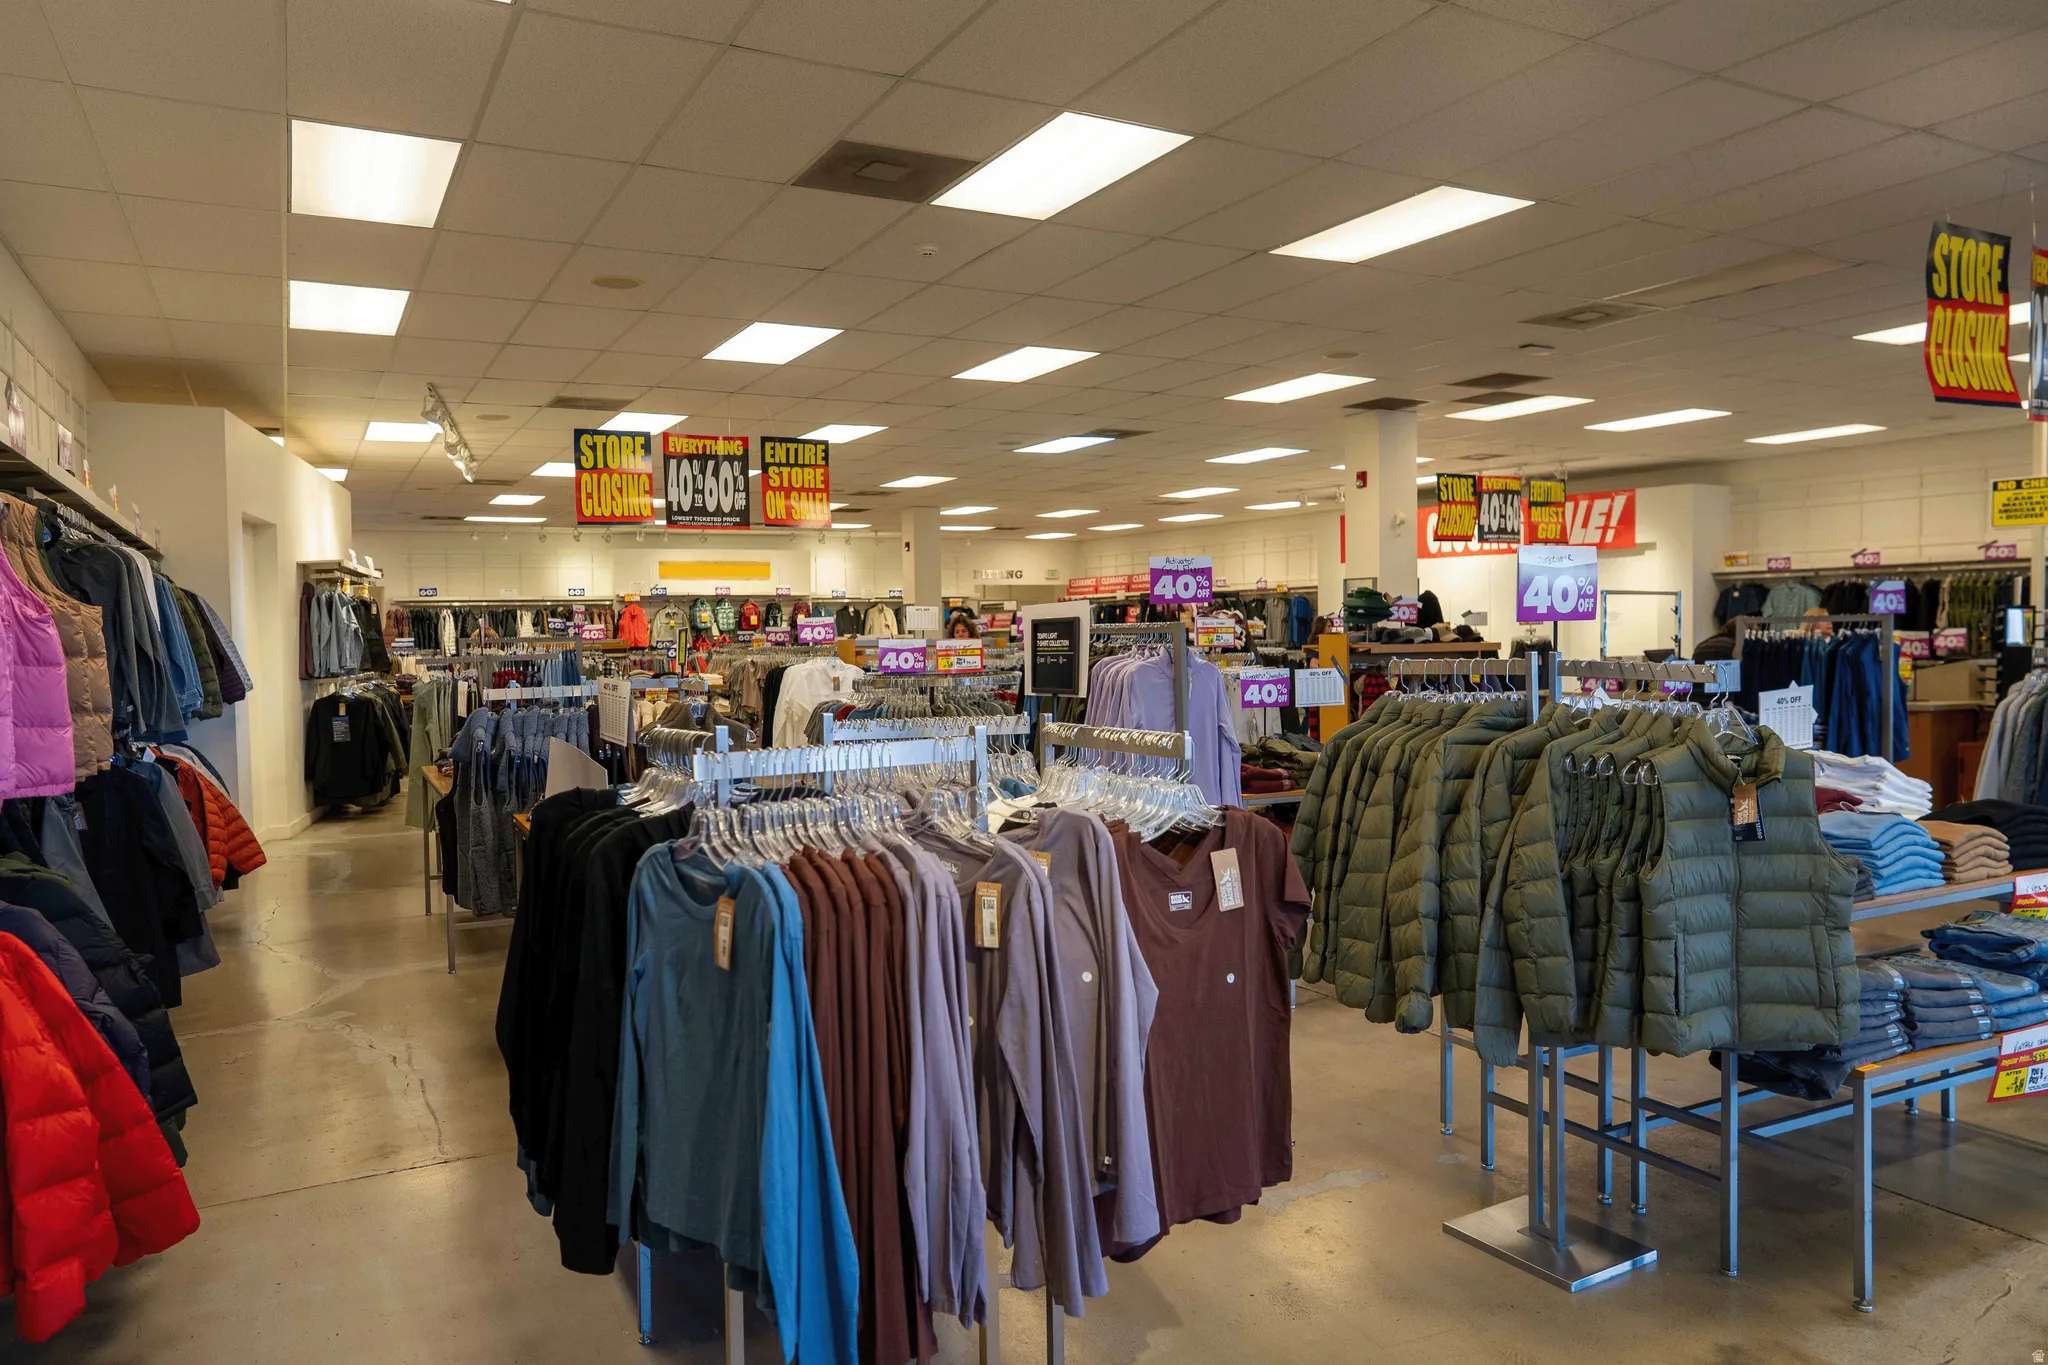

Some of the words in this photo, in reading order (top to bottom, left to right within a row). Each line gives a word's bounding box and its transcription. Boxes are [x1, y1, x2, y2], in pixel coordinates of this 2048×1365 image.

[1932, 233, 2004, 306] STORE
[1930, 305, 2014, 392] CLOSING
[580, 434, 646, 469] STORE
[668, 436, 743, 456] EVERYTHING
[765, 442, 825, 465] ENTIRE
[668, 458, 703, 511] 40%
[695, 493, 703, 506] TO
[704, 460, 744, 513] 60%
[734, 492, 746, 510] OFF
[768, 466, 825, 489] STORE
[1997, 480, 2016, 490] NO
[581, 472, 652, 517] CLOSING
[1440, 476, 1474, 502] STORE
[1531, 481, 1565, 502] EVERYTHING
[766, 490, 786, 519] ON
[790, 491, 829, 520] SALE!
[1506, 494, 1521, 532] 60
[1531, 506, 1564, 522] MUST
[1437, 503, 1477, 536] CLOSING
[1565, 495, 1628, 545] LE!
[1537, 523, 1562, 539] GO!
[973, 569, 1023, 579] FITTING
[1071, 578, 1096, 587] CLEARANCE
[1101, 575, 1128, 585] CLEARANCE
[1154, 575, 1209, 599] 40%
[1197, 589, 1210, 598] OFF
[1523, 575, 1594, 614] 40%
[1578, 598, 1594, 612] OFF
[801, 626, 833, 640] 40%
[882, 652, 924, 669] 40%
[1244, 684, 1287, 704] 40%
[1776, 697, 1789, 705] 40%
[1220, 884, 1228, 907] EDDIE
[1226, 881, 1235, 905] BAUER
[2001, 1057, 2018, 1067] Regular
[2005, 1069, 2022, 1077] AFTER
[2031, 1067, 2039, 1076] YOU
[2029, 1076, 2039, 1084] PAY
